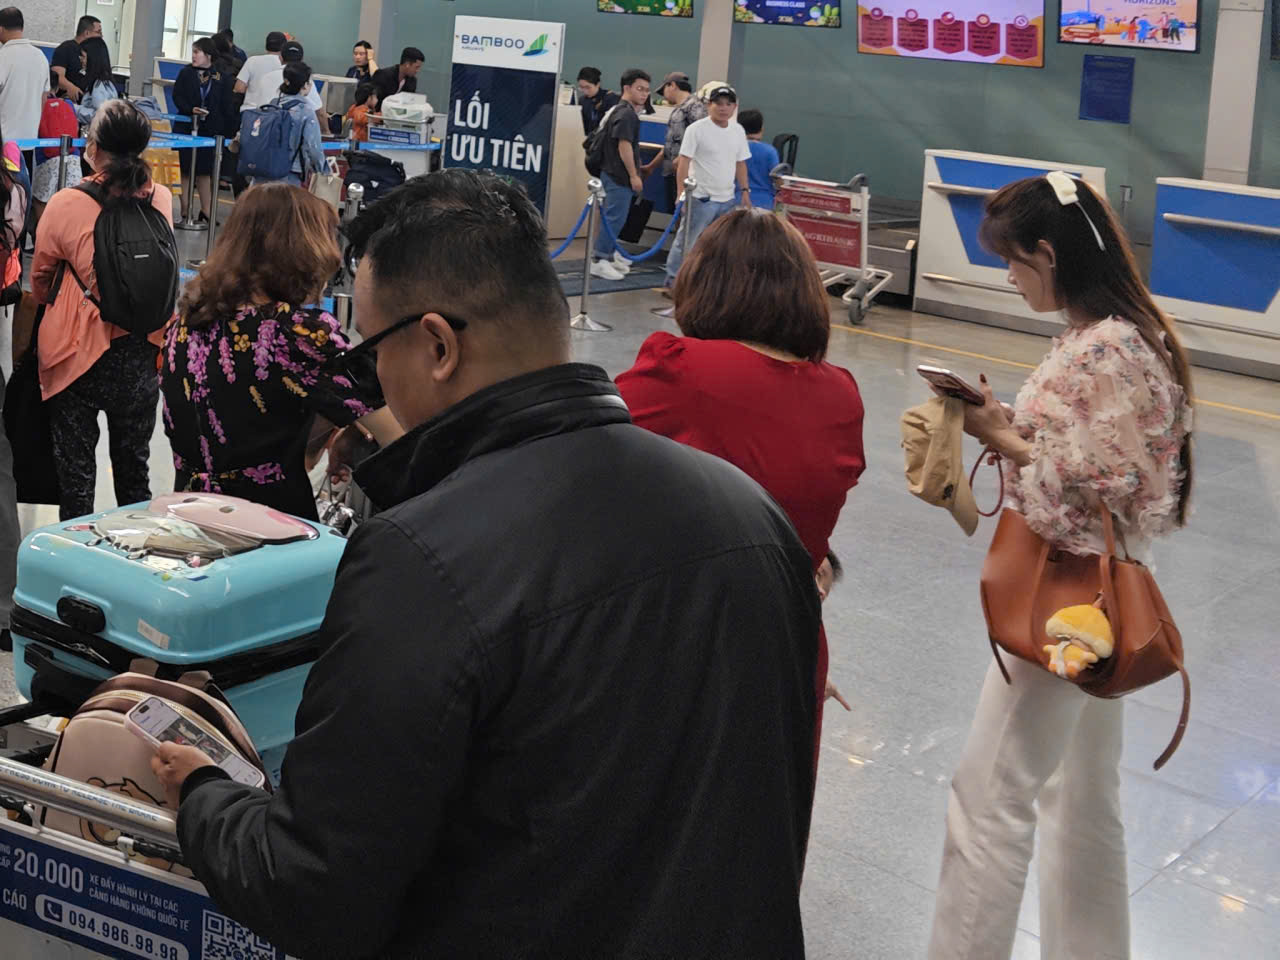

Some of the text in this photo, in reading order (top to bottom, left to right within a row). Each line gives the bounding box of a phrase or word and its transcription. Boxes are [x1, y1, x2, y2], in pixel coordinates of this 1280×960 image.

[460, 33, 526, 50] BAMBOO
[453, 90, 491, 131] LỐI
[450, 132, 486, 164] ƯU
[489, 134, 543, 174] TIÊN
[804, 232, 856, 247] AGRIBANK
[13, 847, 84, 894] 20.000
[2, 887, 28, 912] CÁO
[88, 873, 100, 886] XE
[116, 882, 138, 901] HÀNH
[162, 897, 179, 914] CÁC
[88, 885, 109, 904] CẢNG
[109, 891, 130, 910] HÀNG
[131, 900, 157, 920] KHÔNG
[157, 908, 179, 928] QUỐC
[69, 908, 179, 960] 094.986.98.98
